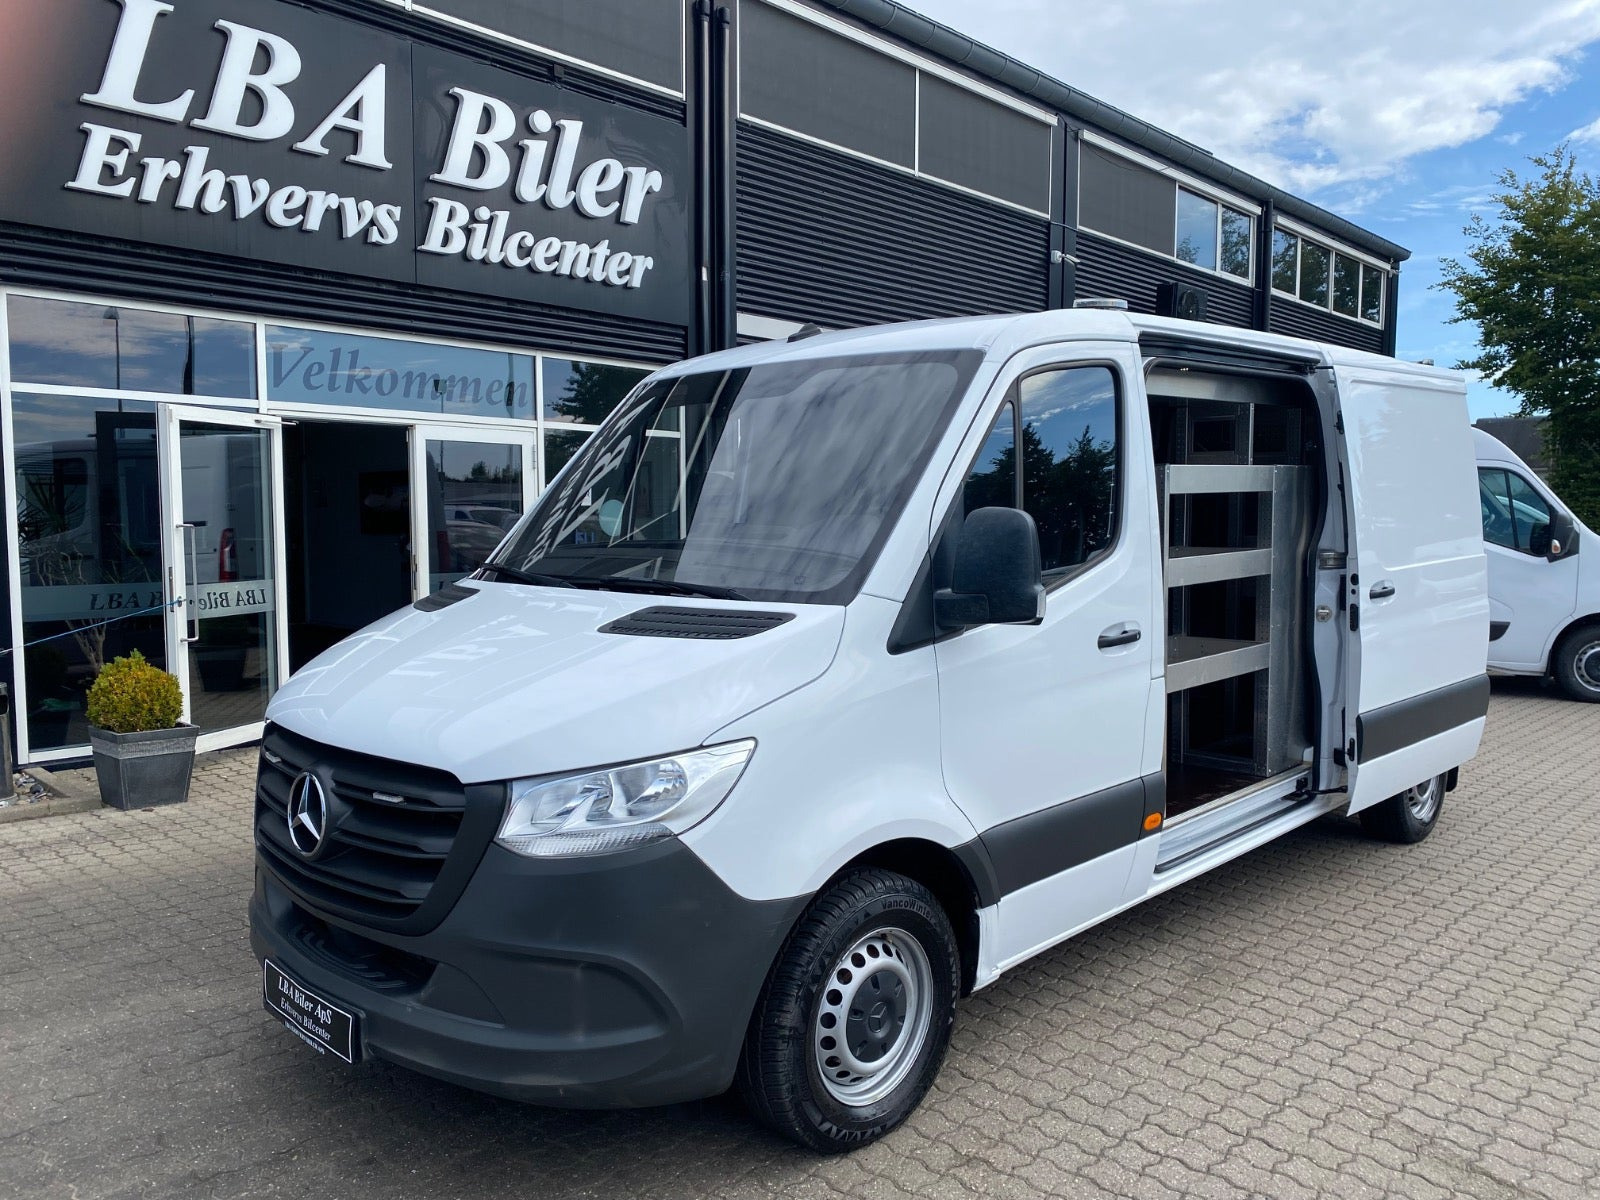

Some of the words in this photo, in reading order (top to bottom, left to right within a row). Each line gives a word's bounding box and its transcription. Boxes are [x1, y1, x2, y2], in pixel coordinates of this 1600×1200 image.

[80, 0, 393, 171] LBA
[429, 85, 663, 226] Biler
[64, 121, 402, 246] Erhvervs
[417, 195, 654, 289] Bilcenter
[267, 343, 529, 409] Velkommen
[89, 591, 142, 611] LBA
[278, 976, 294, 1000] LBA
[294, 988, 314, 1012] Biler
[314, 1003, 332, 1025] ApS
[303, 1014, 332, 1041] Bilcenter
